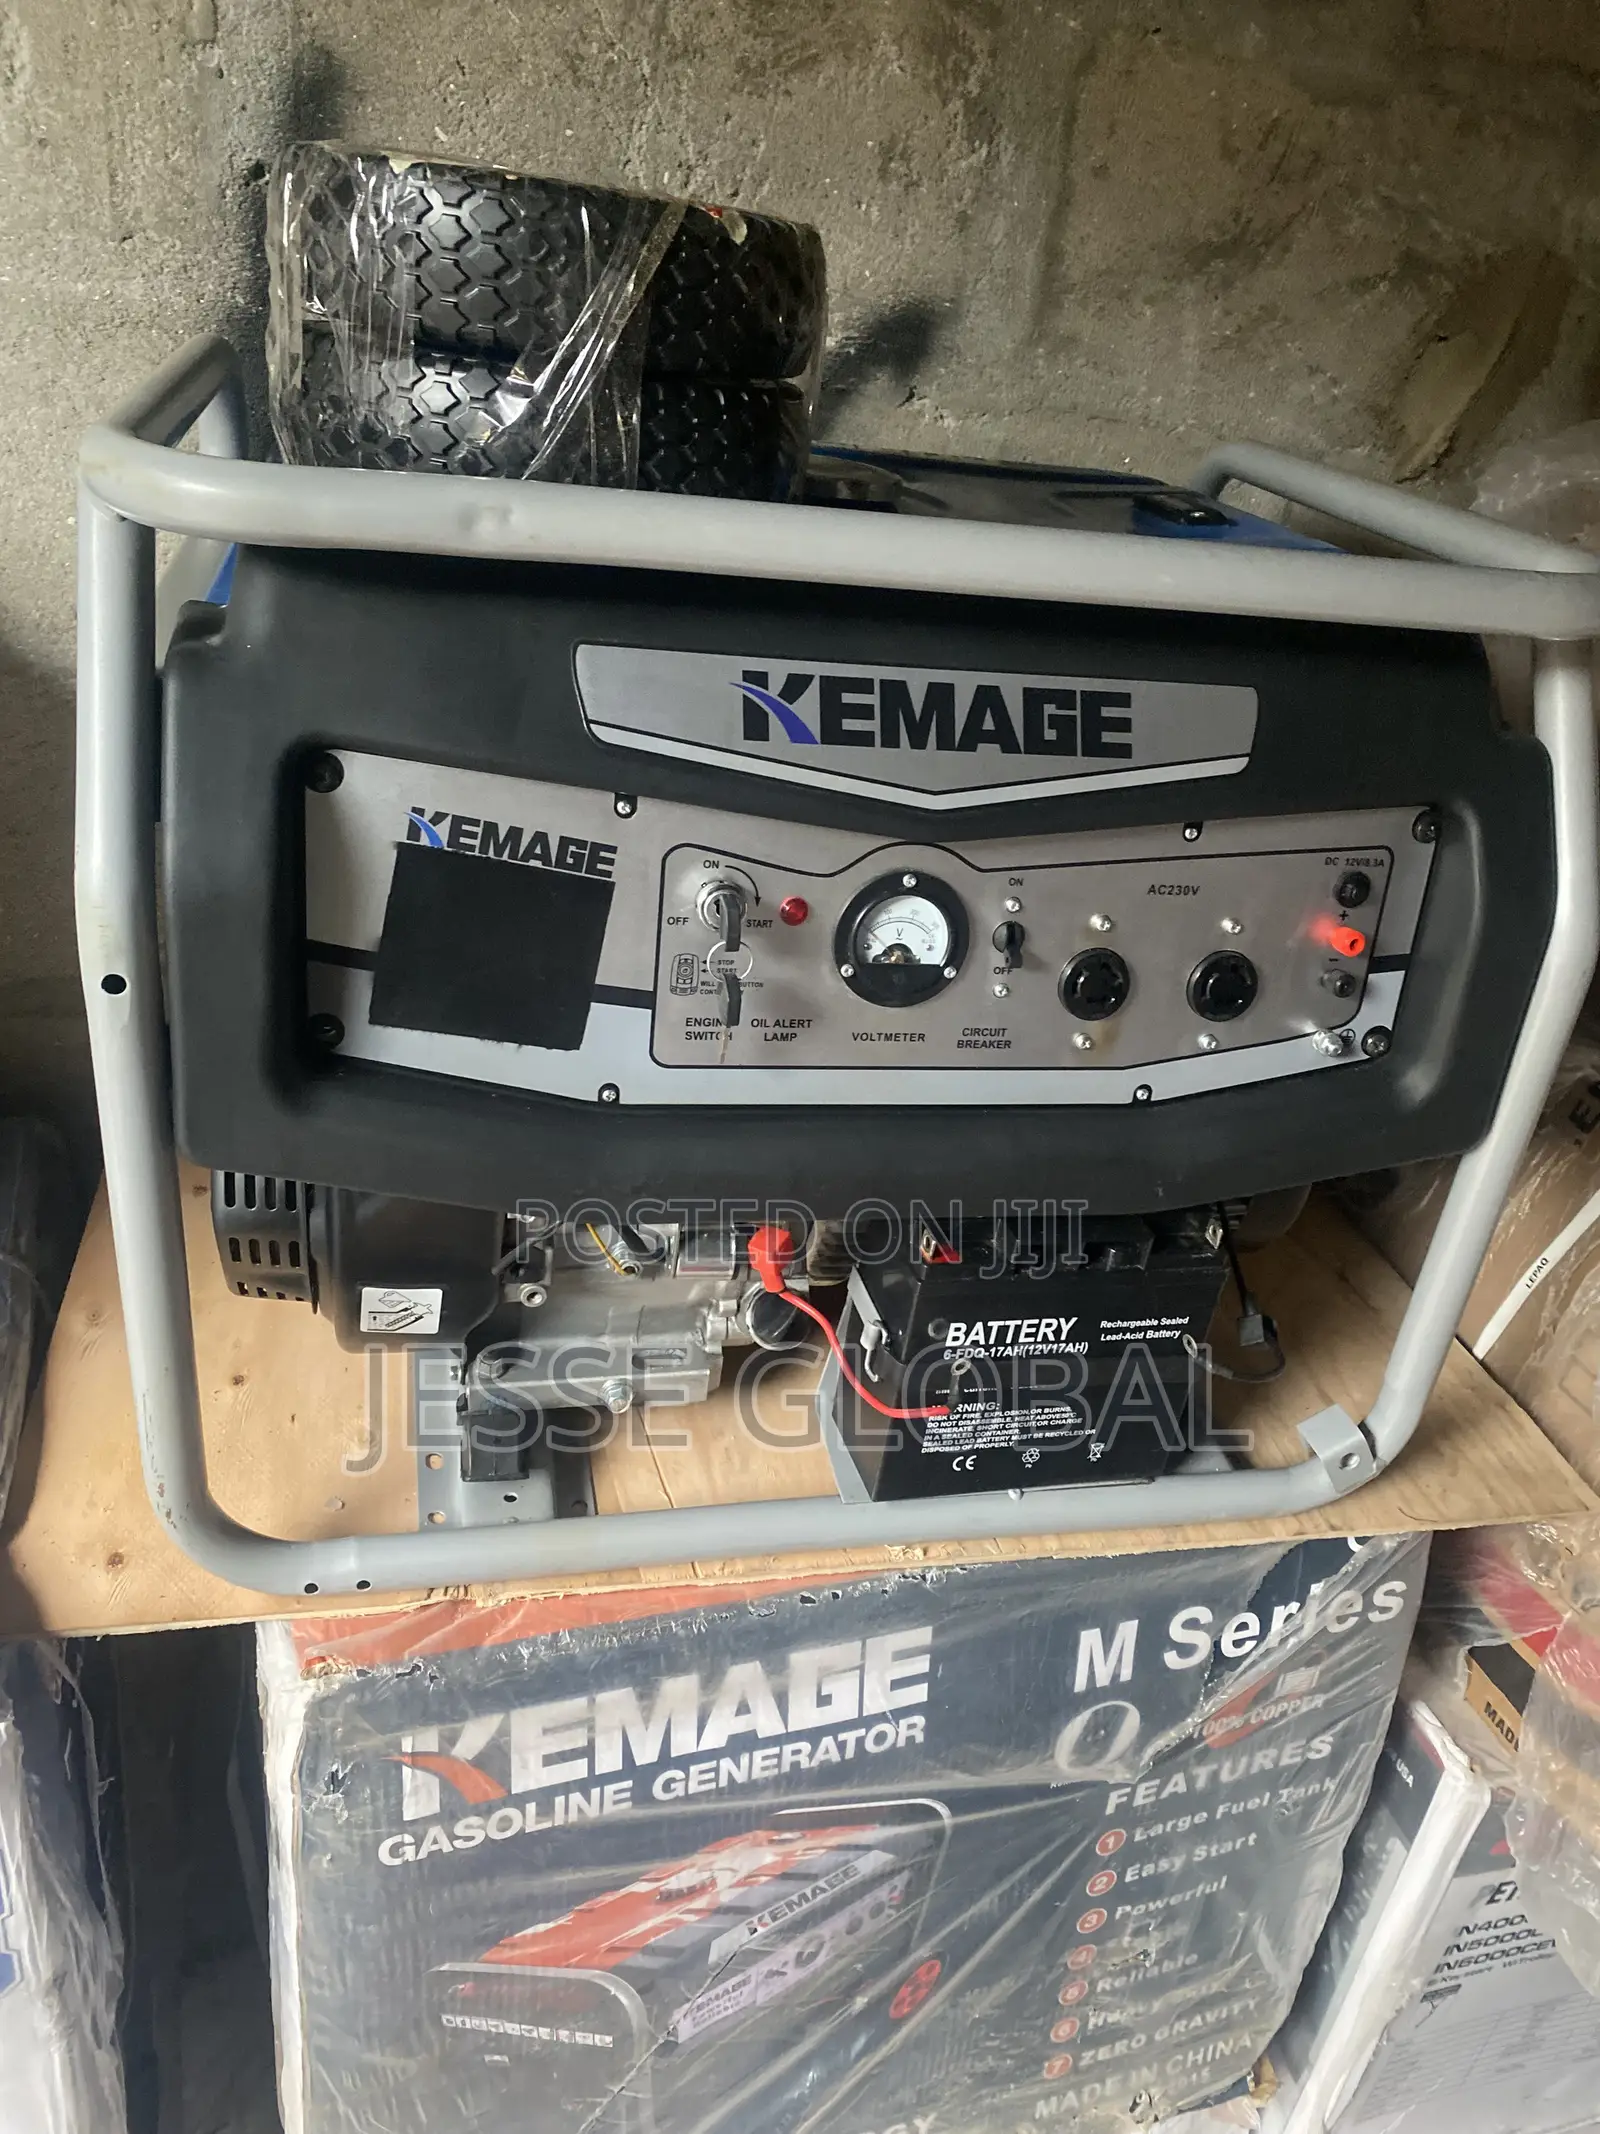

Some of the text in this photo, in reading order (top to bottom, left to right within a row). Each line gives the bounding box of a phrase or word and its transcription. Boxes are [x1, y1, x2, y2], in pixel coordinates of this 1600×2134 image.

[731, 669, 1132, 759] KEMAGE
[404, 806, 618, 879] KEMAGE
[703, 860, 720, 870] ON
[1324, 856, 1340, 866] DC
[1008, 877, 1025, 887] ON
[1147, 884, 1201, 896] AC230V
[667, 916, 690, 926] OFF
[746, 919, 774, 929] START
[993, 966, 1013, 976] OFF
[685, 1017, 725, 1028] ENGIN
[750, 1018, 813, 1029] OIL ALERT
[764, 1032, 798, 1042] LAMP
[852, 1032, 926, 1042] VOLTMETER
[962, 1027, 1008, 1038] CIRCUIT
[956, 1039, 1012, 1049] BREAKER
[1100, 1316, 1190, 1330] Rechargeable Sealed
[945, 1316, 1079, 1348] BATTERY
[1100, 1329, 1182, 1342] Lead-Acid Battery
[949, 1413, 962, 1421] OF
[926, 1421, 939, 1429] DO
[976, 1423, 1004, 1431] SHORT
[1049, 1417, 1084, 1426] CHARGE
[922, 1428, 1097, 1448] SEALED LEAD BATTERY MUST BE RECYCLED OR
[923, 1434, 933, 1442] IN
[941, 1432, 974, 1441] SEALED
[920, 1446, 961, 1454] DISPOSED
[952, 1454, 978, 1472] CE
[1073, 1580, 1409, 1694] M Series
[383, 1626, 934, 1822] KEMAGE
[1104, 1734, 1334, 1816] FEATURES
[376, 1714, 926, 1869] GASOLINE GENERATOR
[1133, 1810, 1210, 1843] Large
[1214, 1791, 1272, 1821] Fuel
[1124, 1854, 1187, 1885] Easy
[1192, 1831, 1259, 1863] Start
[744, 1864, 863, 1937] KEMAGE
[1114, 1875, 1229, 1921] Powerful
[1078, 2032, 1148, 2067] ZERO
[1153, 1996, 1259, 2043] GRAVITY
[1165, 2031, 1253, 2077] CHINA
